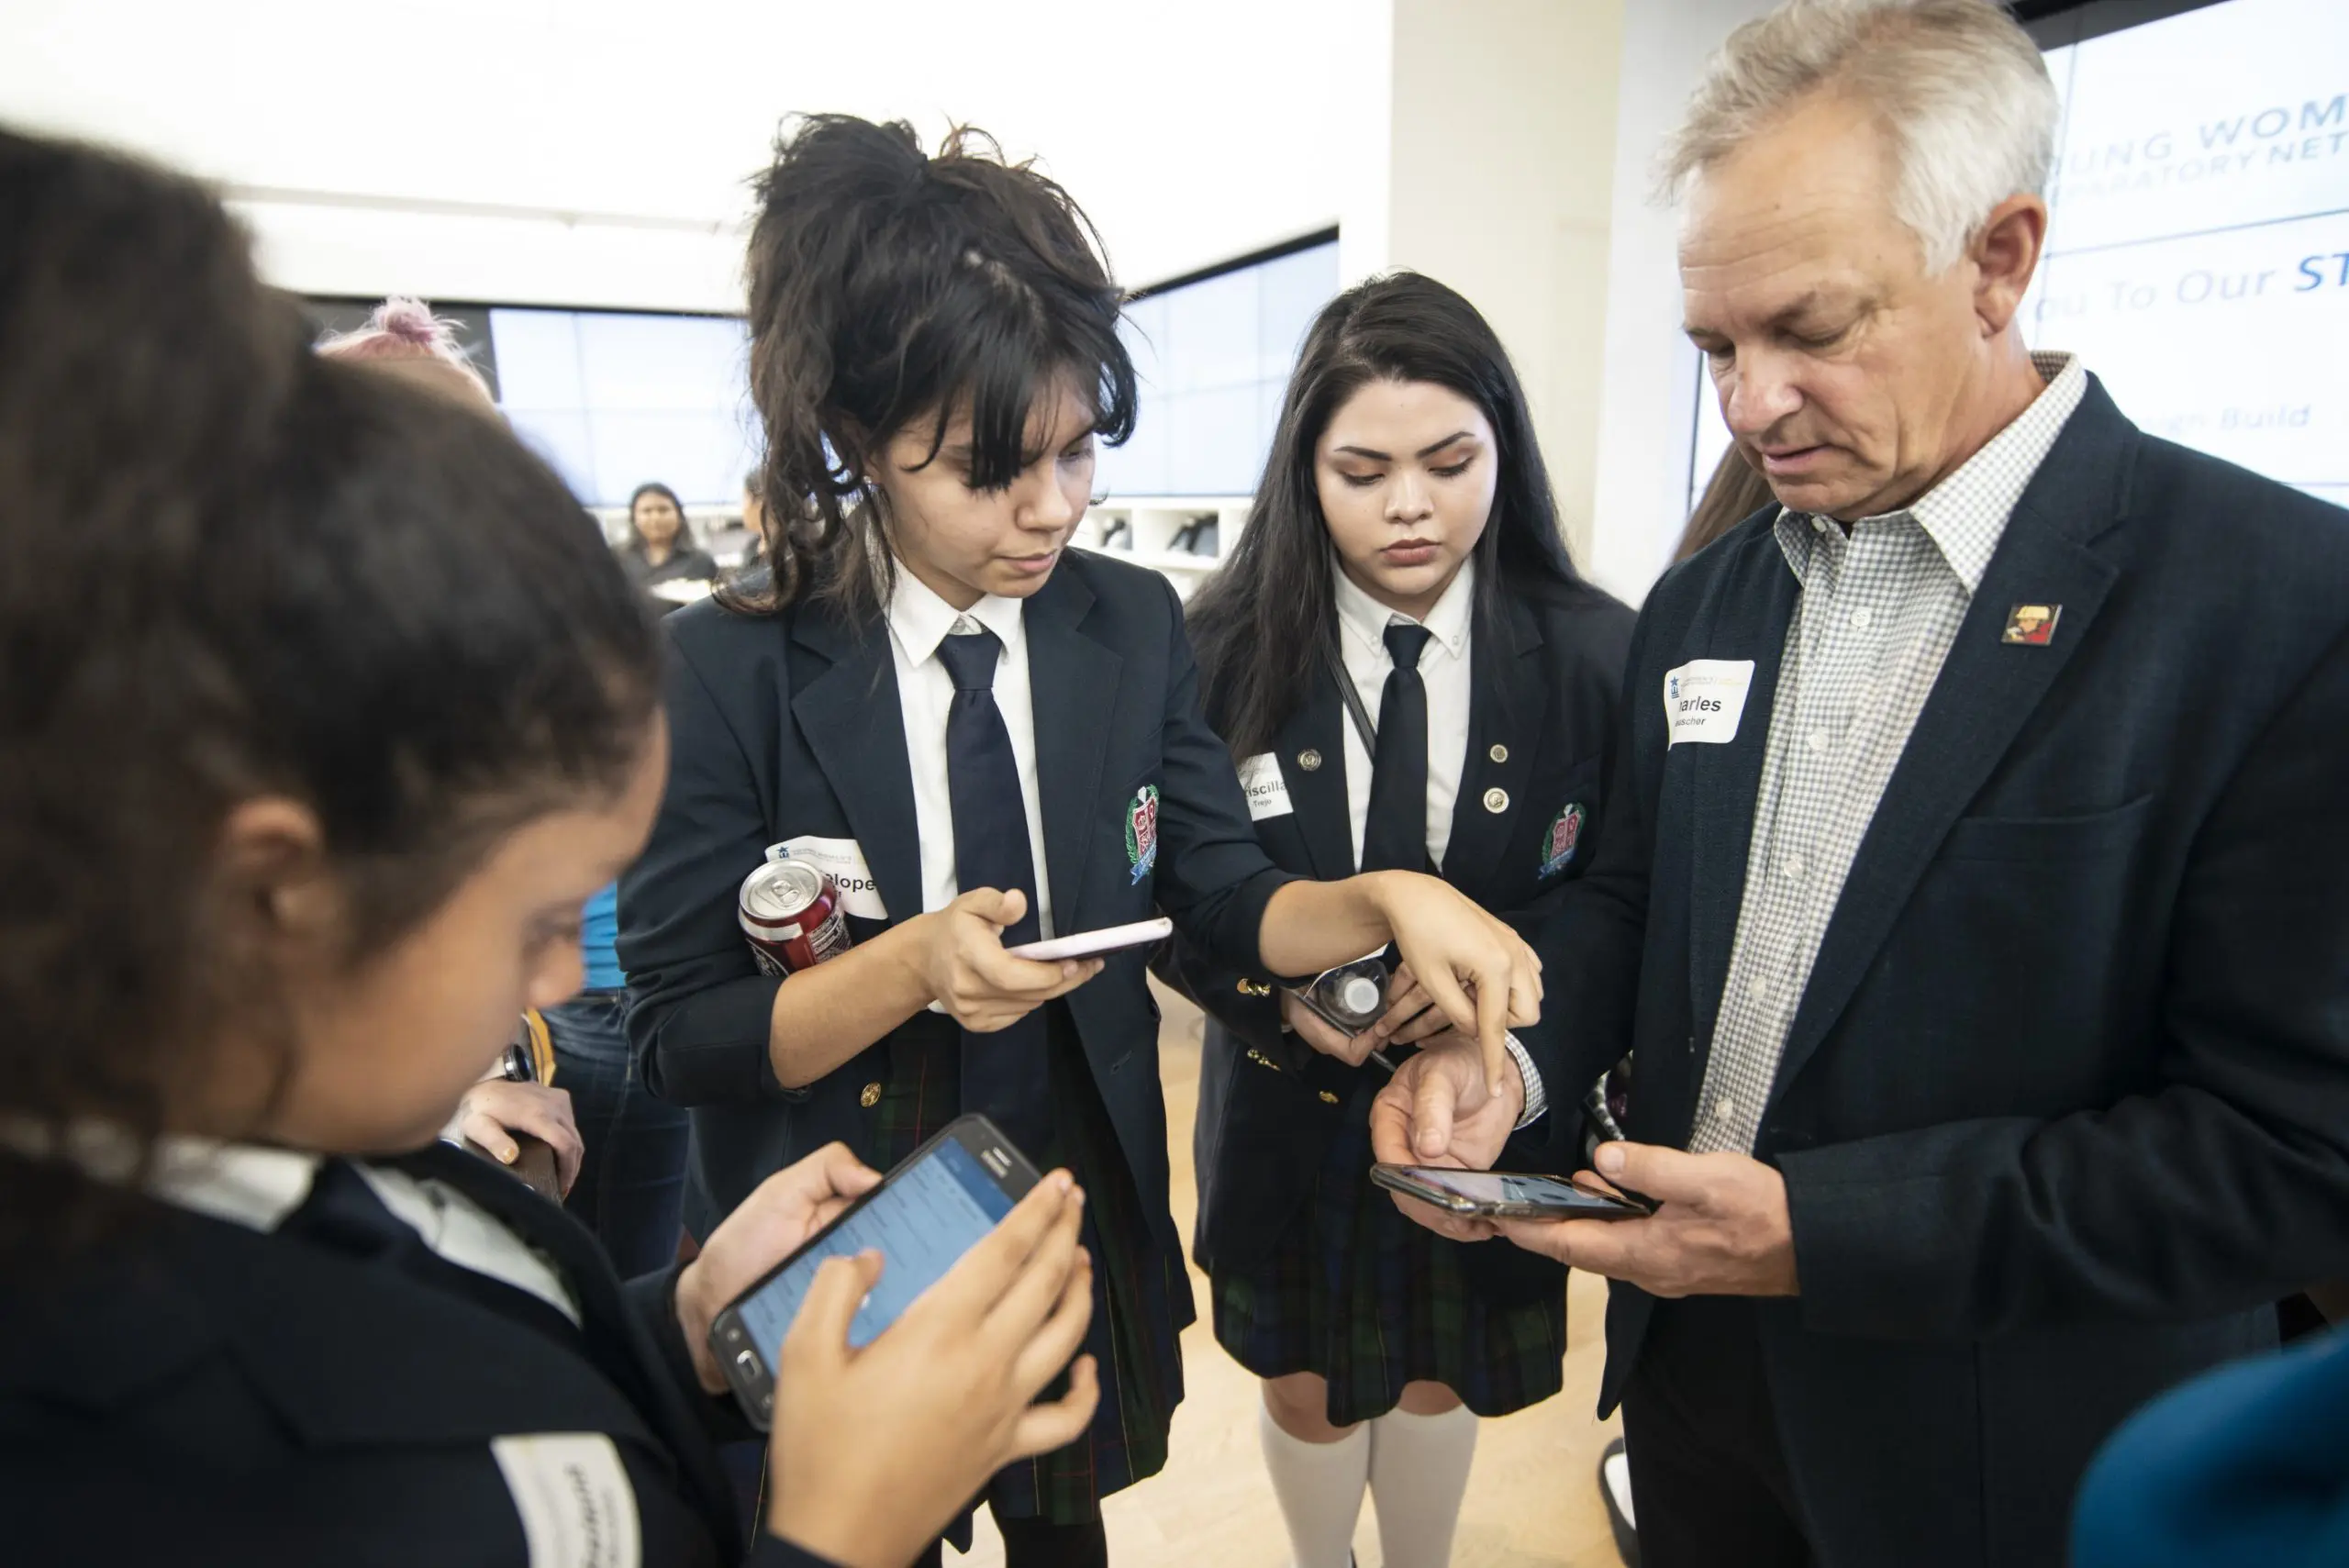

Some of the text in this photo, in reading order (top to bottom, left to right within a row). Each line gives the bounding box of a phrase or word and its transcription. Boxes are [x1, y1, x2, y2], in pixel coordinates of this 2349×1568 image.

[2055, 93, 2347, 177] UNG WOM
[2109, 278, 2157, 312] To
[2176, 267, 2276, 305] Our
[2220, 401, 2312, 431] Build
